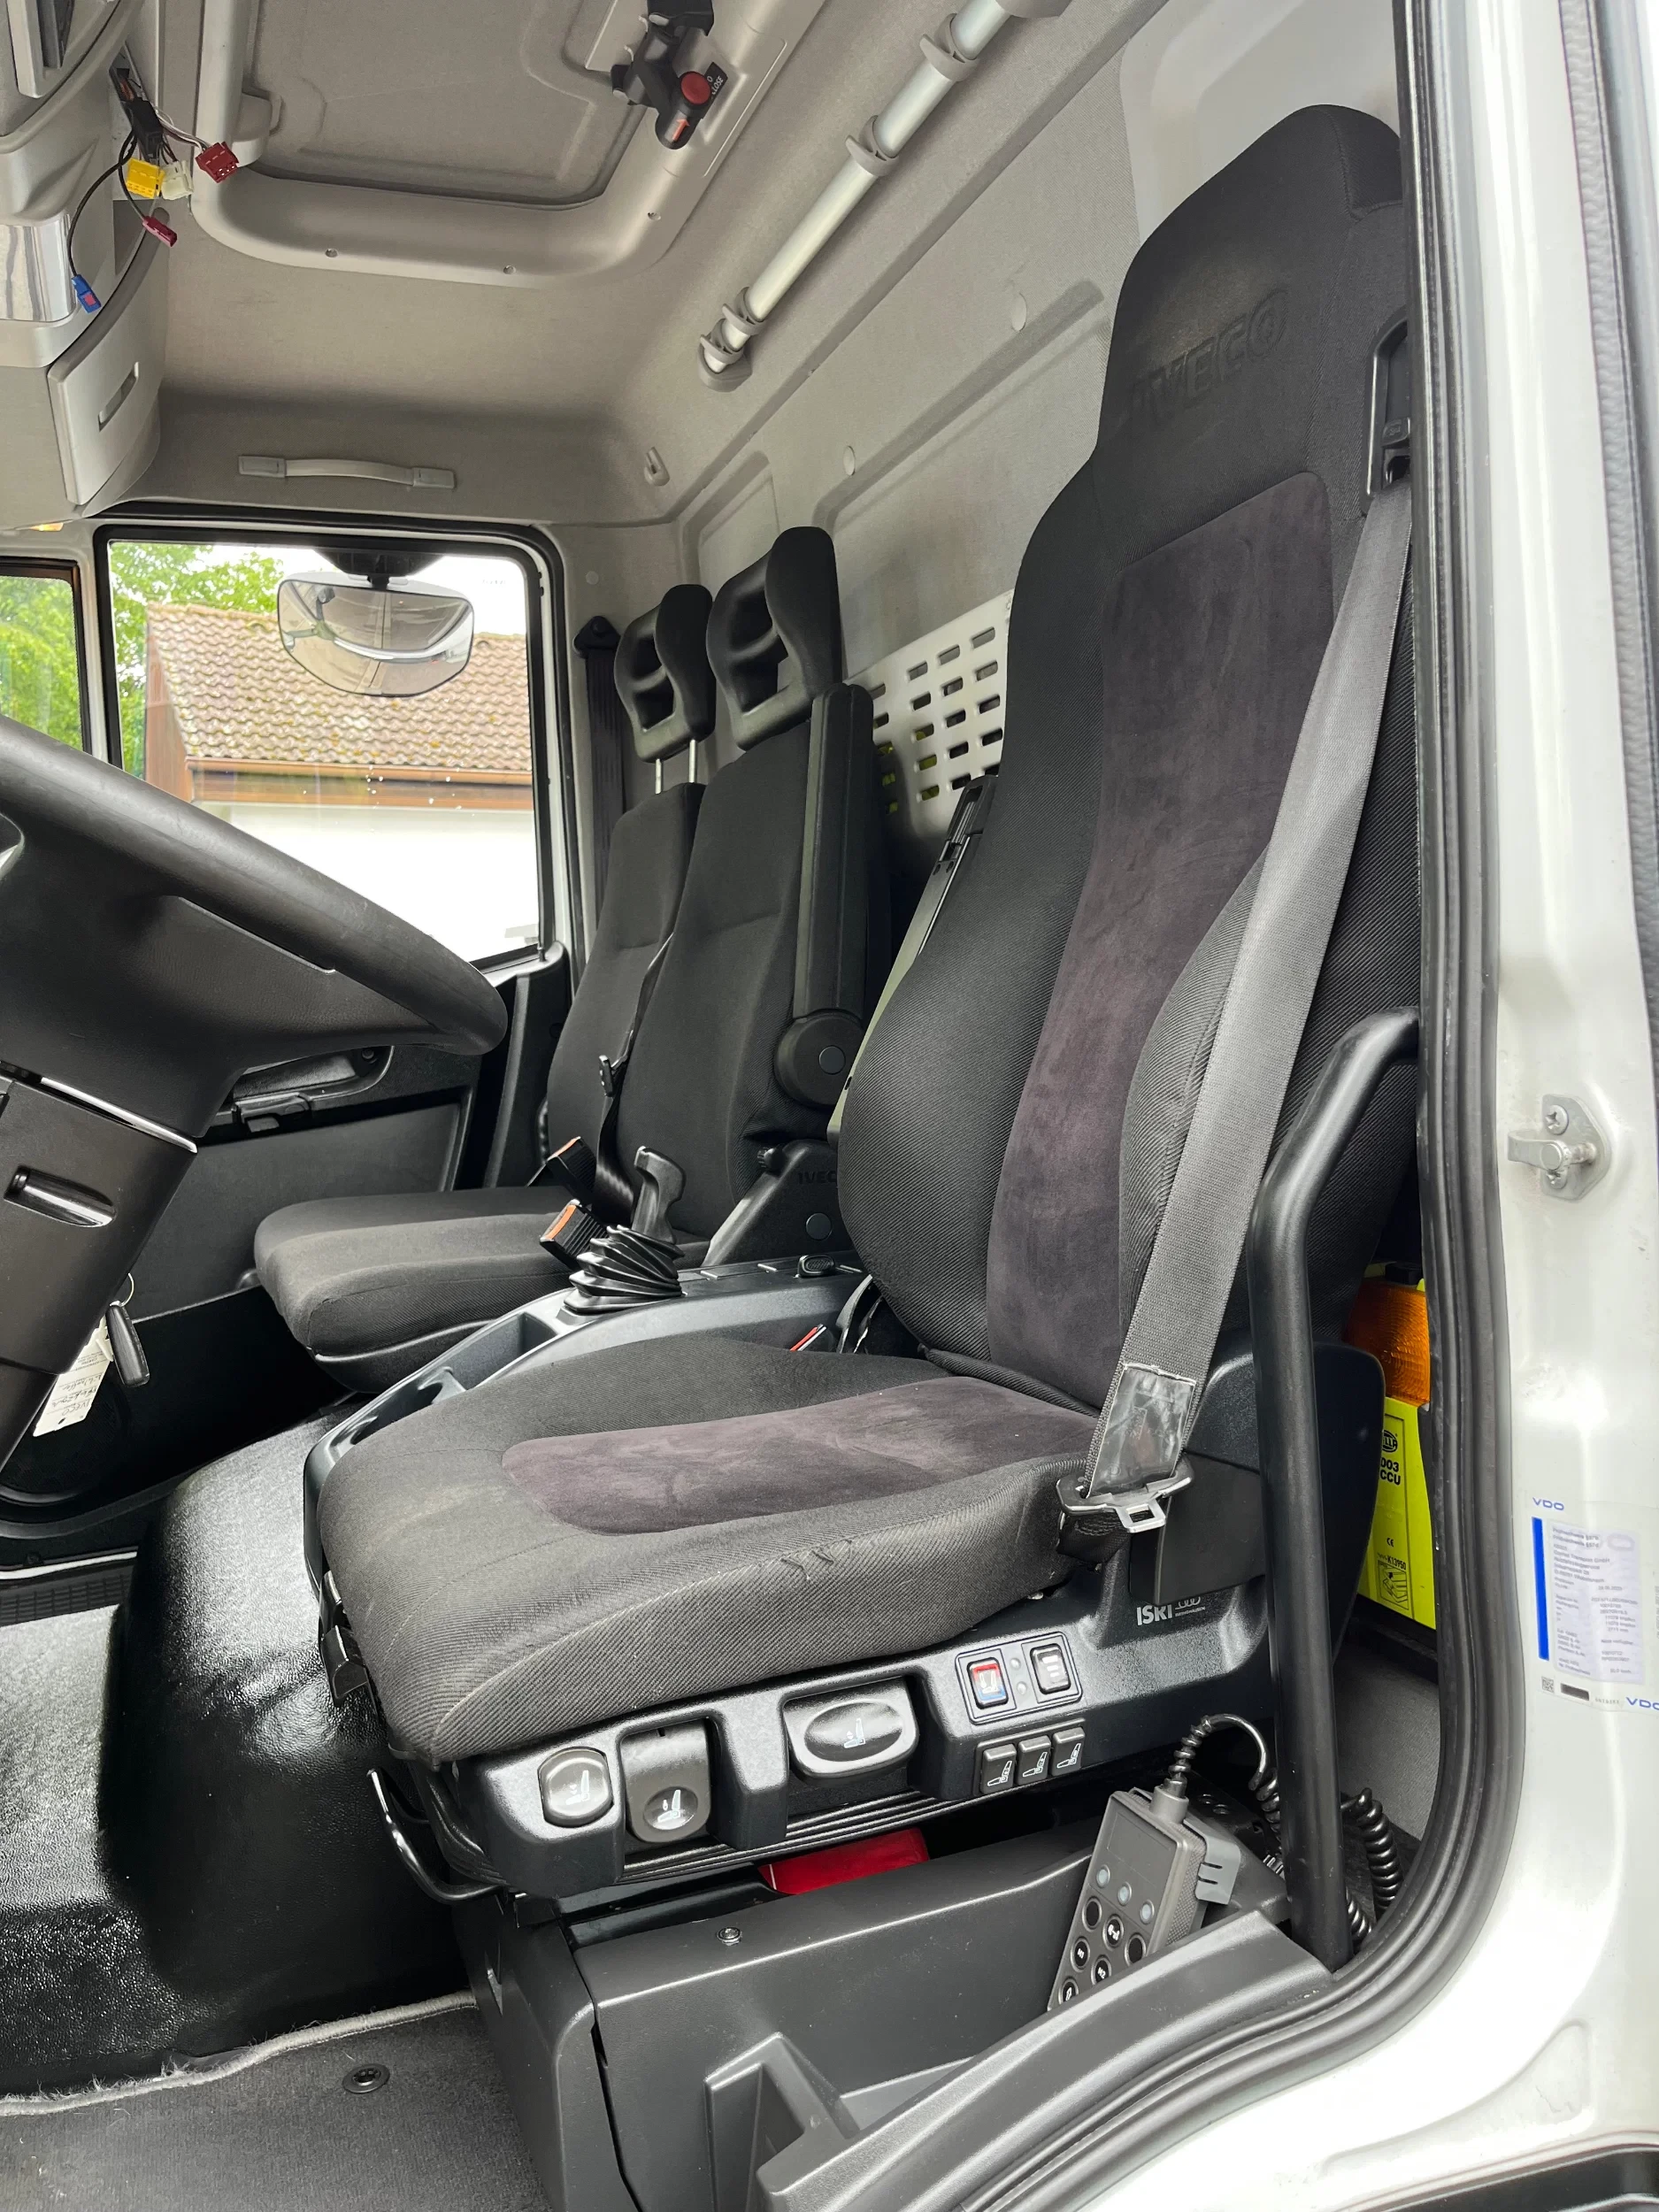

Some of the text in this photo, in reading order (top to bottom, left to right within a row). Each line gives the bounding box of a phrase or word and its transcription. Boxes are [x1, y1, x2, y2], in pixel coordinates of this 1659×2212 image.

[1129, 289, 1288, 426] IVECO
[798, 1170, 837, 1184] IVEC
[1532, 1497, 1564, 1510] VDO
